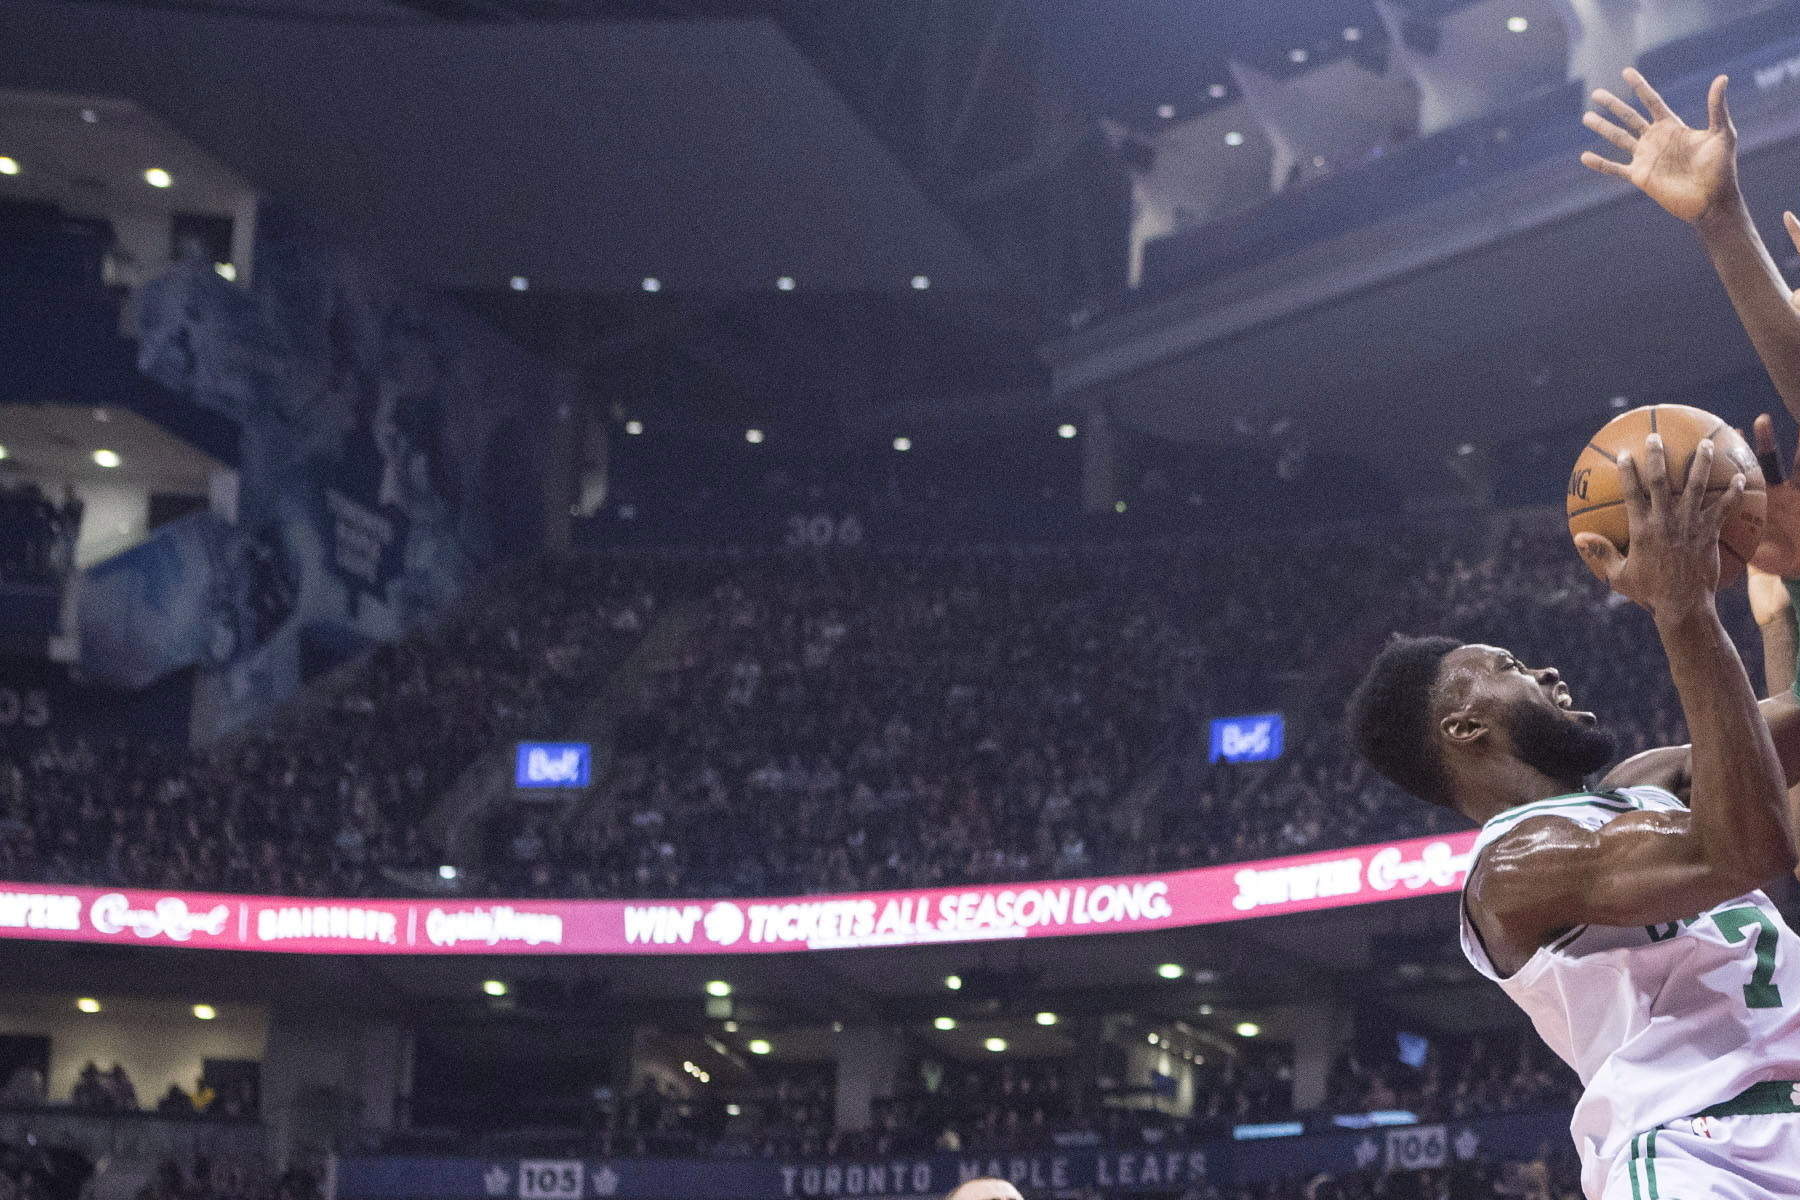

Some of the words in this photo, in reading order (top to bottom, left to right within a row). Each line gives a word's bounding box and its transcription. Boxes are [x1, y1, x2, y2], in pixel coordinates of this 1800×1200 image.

[748, 899, 878, 944] TICKETS
[876, 896, 938, 936] ALL
[936, 887, 1071, 934] SEASON
[1710, 906, 1783, 1008] 7
[525, 1167, 577, 1193] 105
[781, 1162, 932, 1197] TORONTO
[1098, 1151, 1207, 1187] LEAFS
